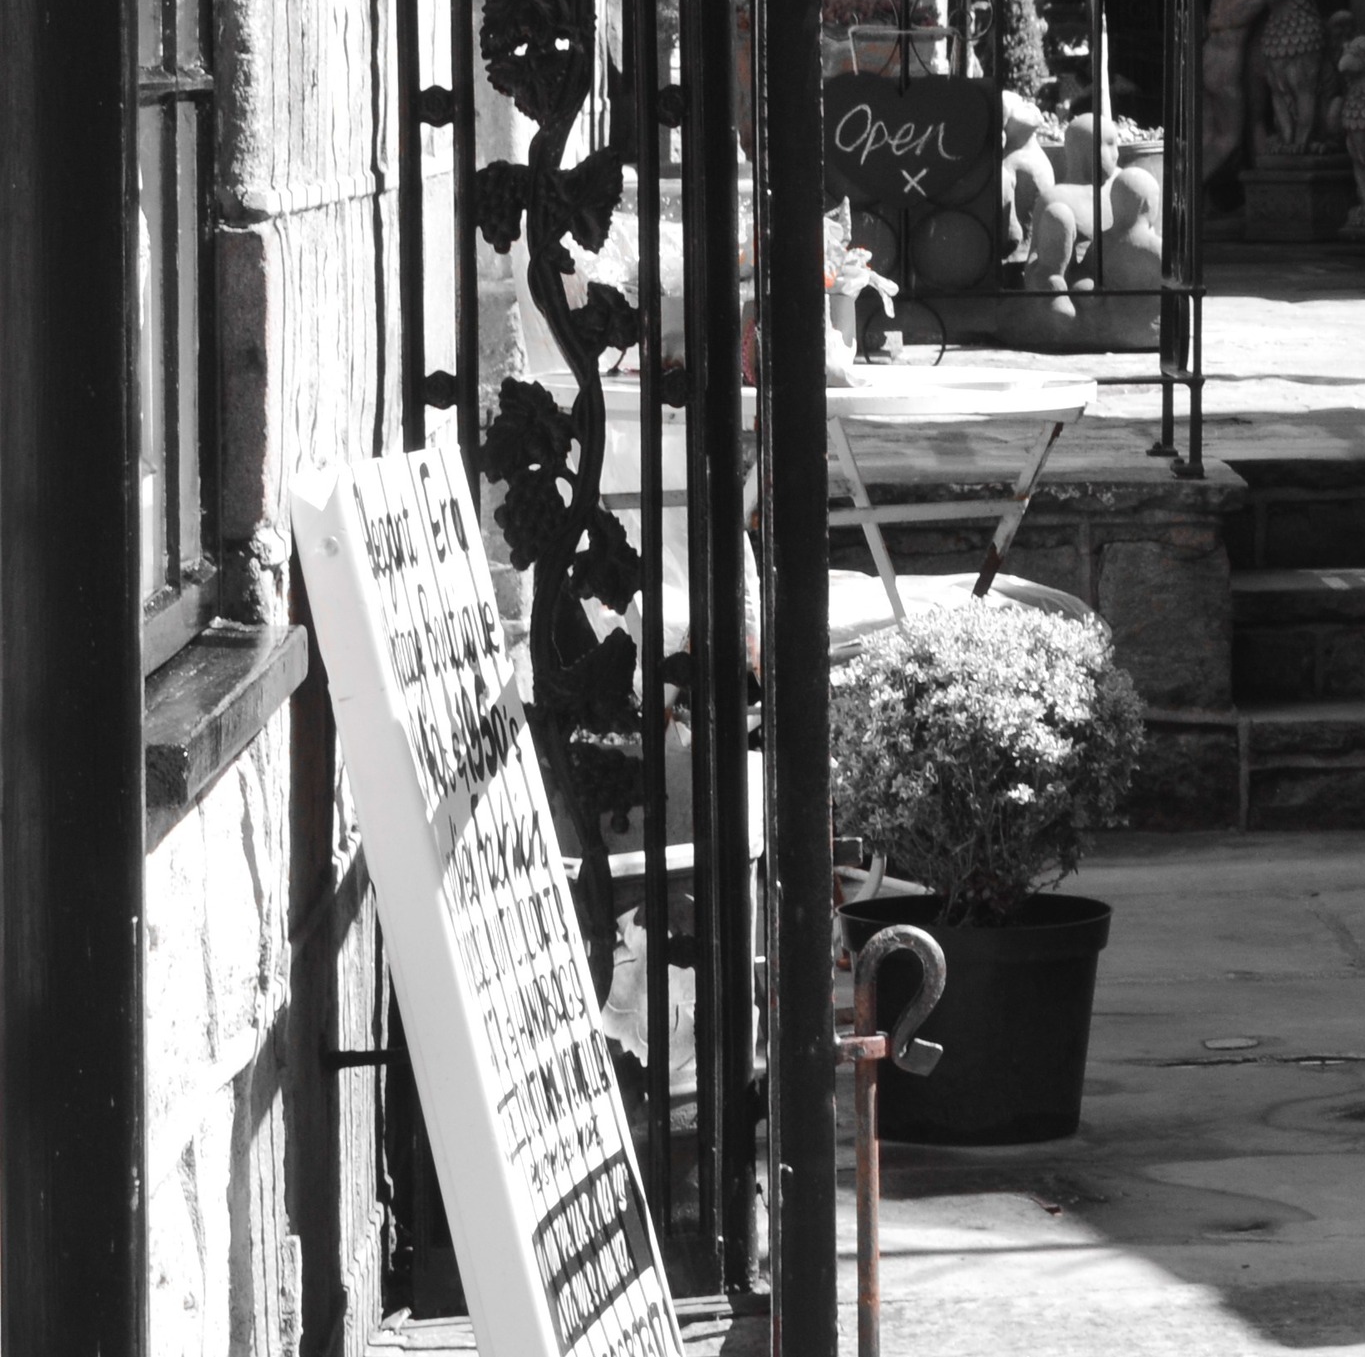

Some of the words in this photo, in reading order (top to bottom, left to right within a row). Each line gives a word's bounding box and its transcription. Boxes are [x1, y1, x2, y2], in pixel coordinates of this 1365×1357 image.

[835, 104, 962, 166] Open
[419, 461, 470, 564] Era
[417, 582, 501, 694] Boutique
[510, 957, 586, 1057] HANDBAGS
